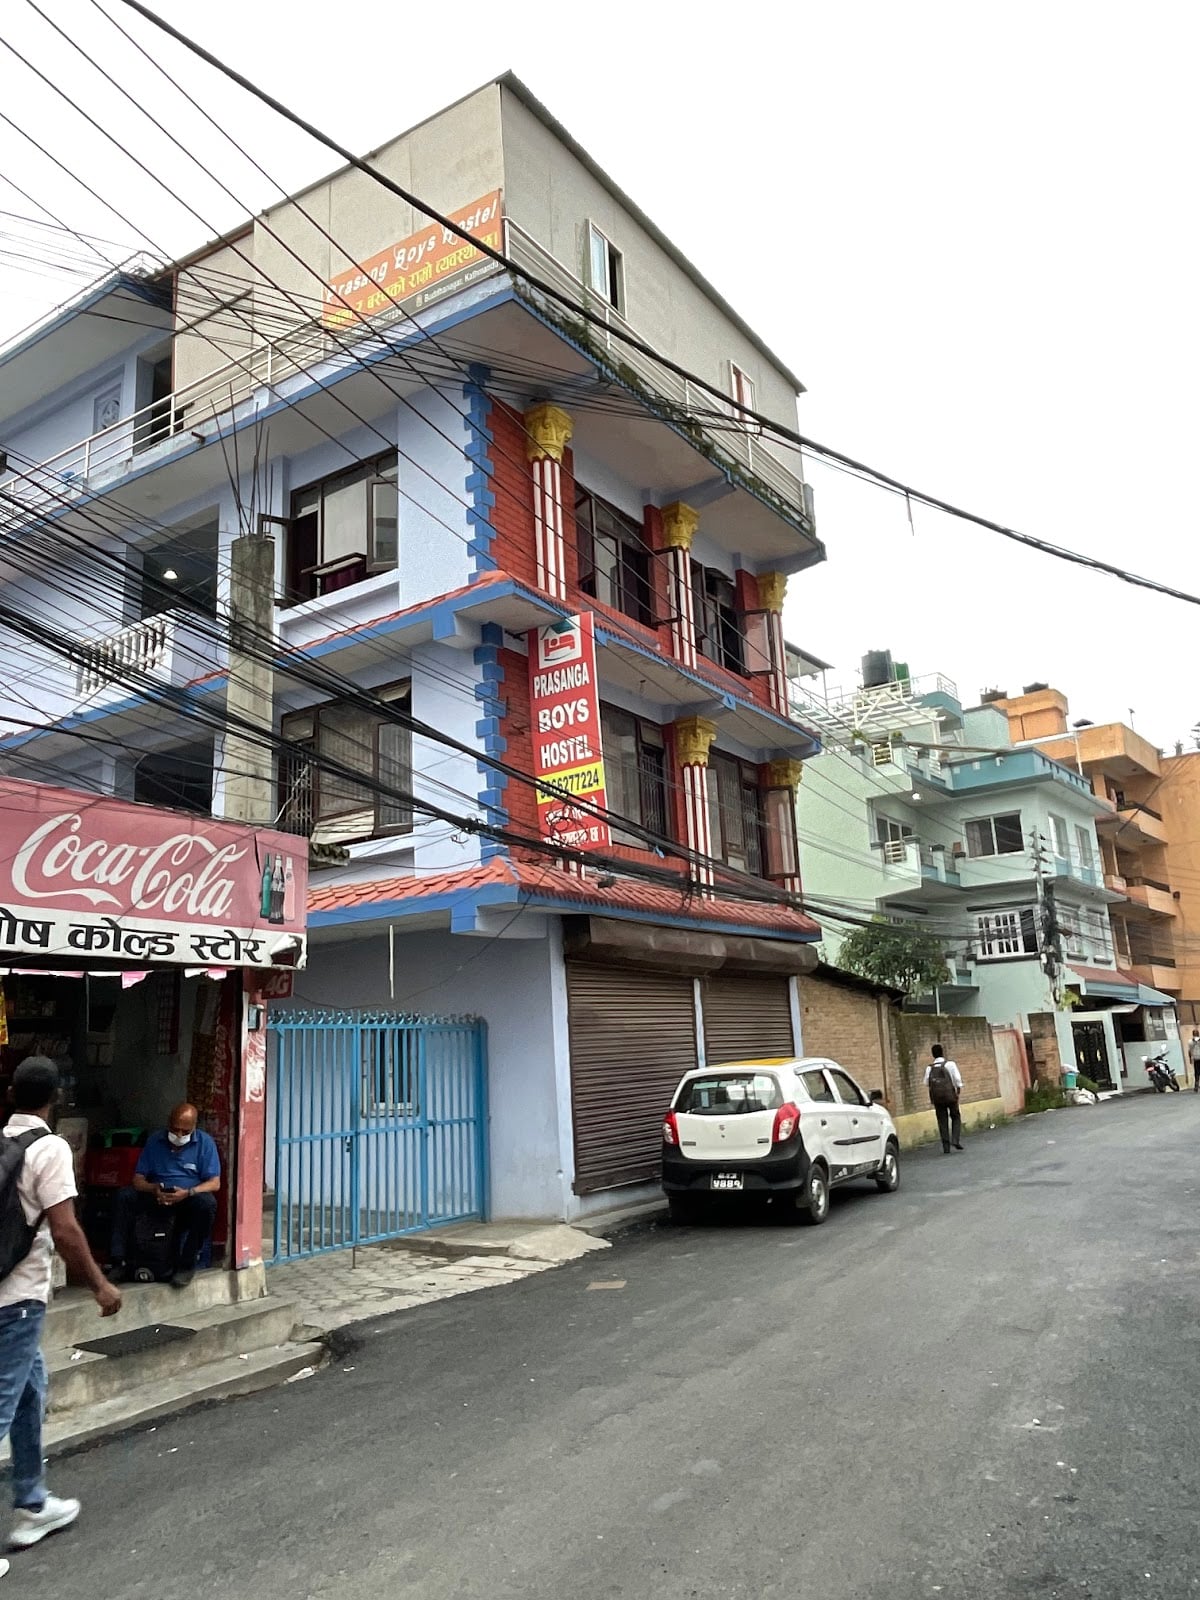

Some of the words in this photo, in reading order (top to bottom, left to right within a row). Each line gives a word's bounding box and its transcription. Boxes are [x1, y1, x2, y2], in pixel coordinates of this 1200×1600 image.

[394, 235, 436, 270] Boys
[534, 662, 590, 699] PRASANGA
[538, 699, 590, 733] BOYS
[541, 734, 593, 769] HOSTEL
[12, 813, 248, 920] Coca-Cola
[190, 930, 266, 963] स्टोर
[264, 973, 290, 996] 4G
